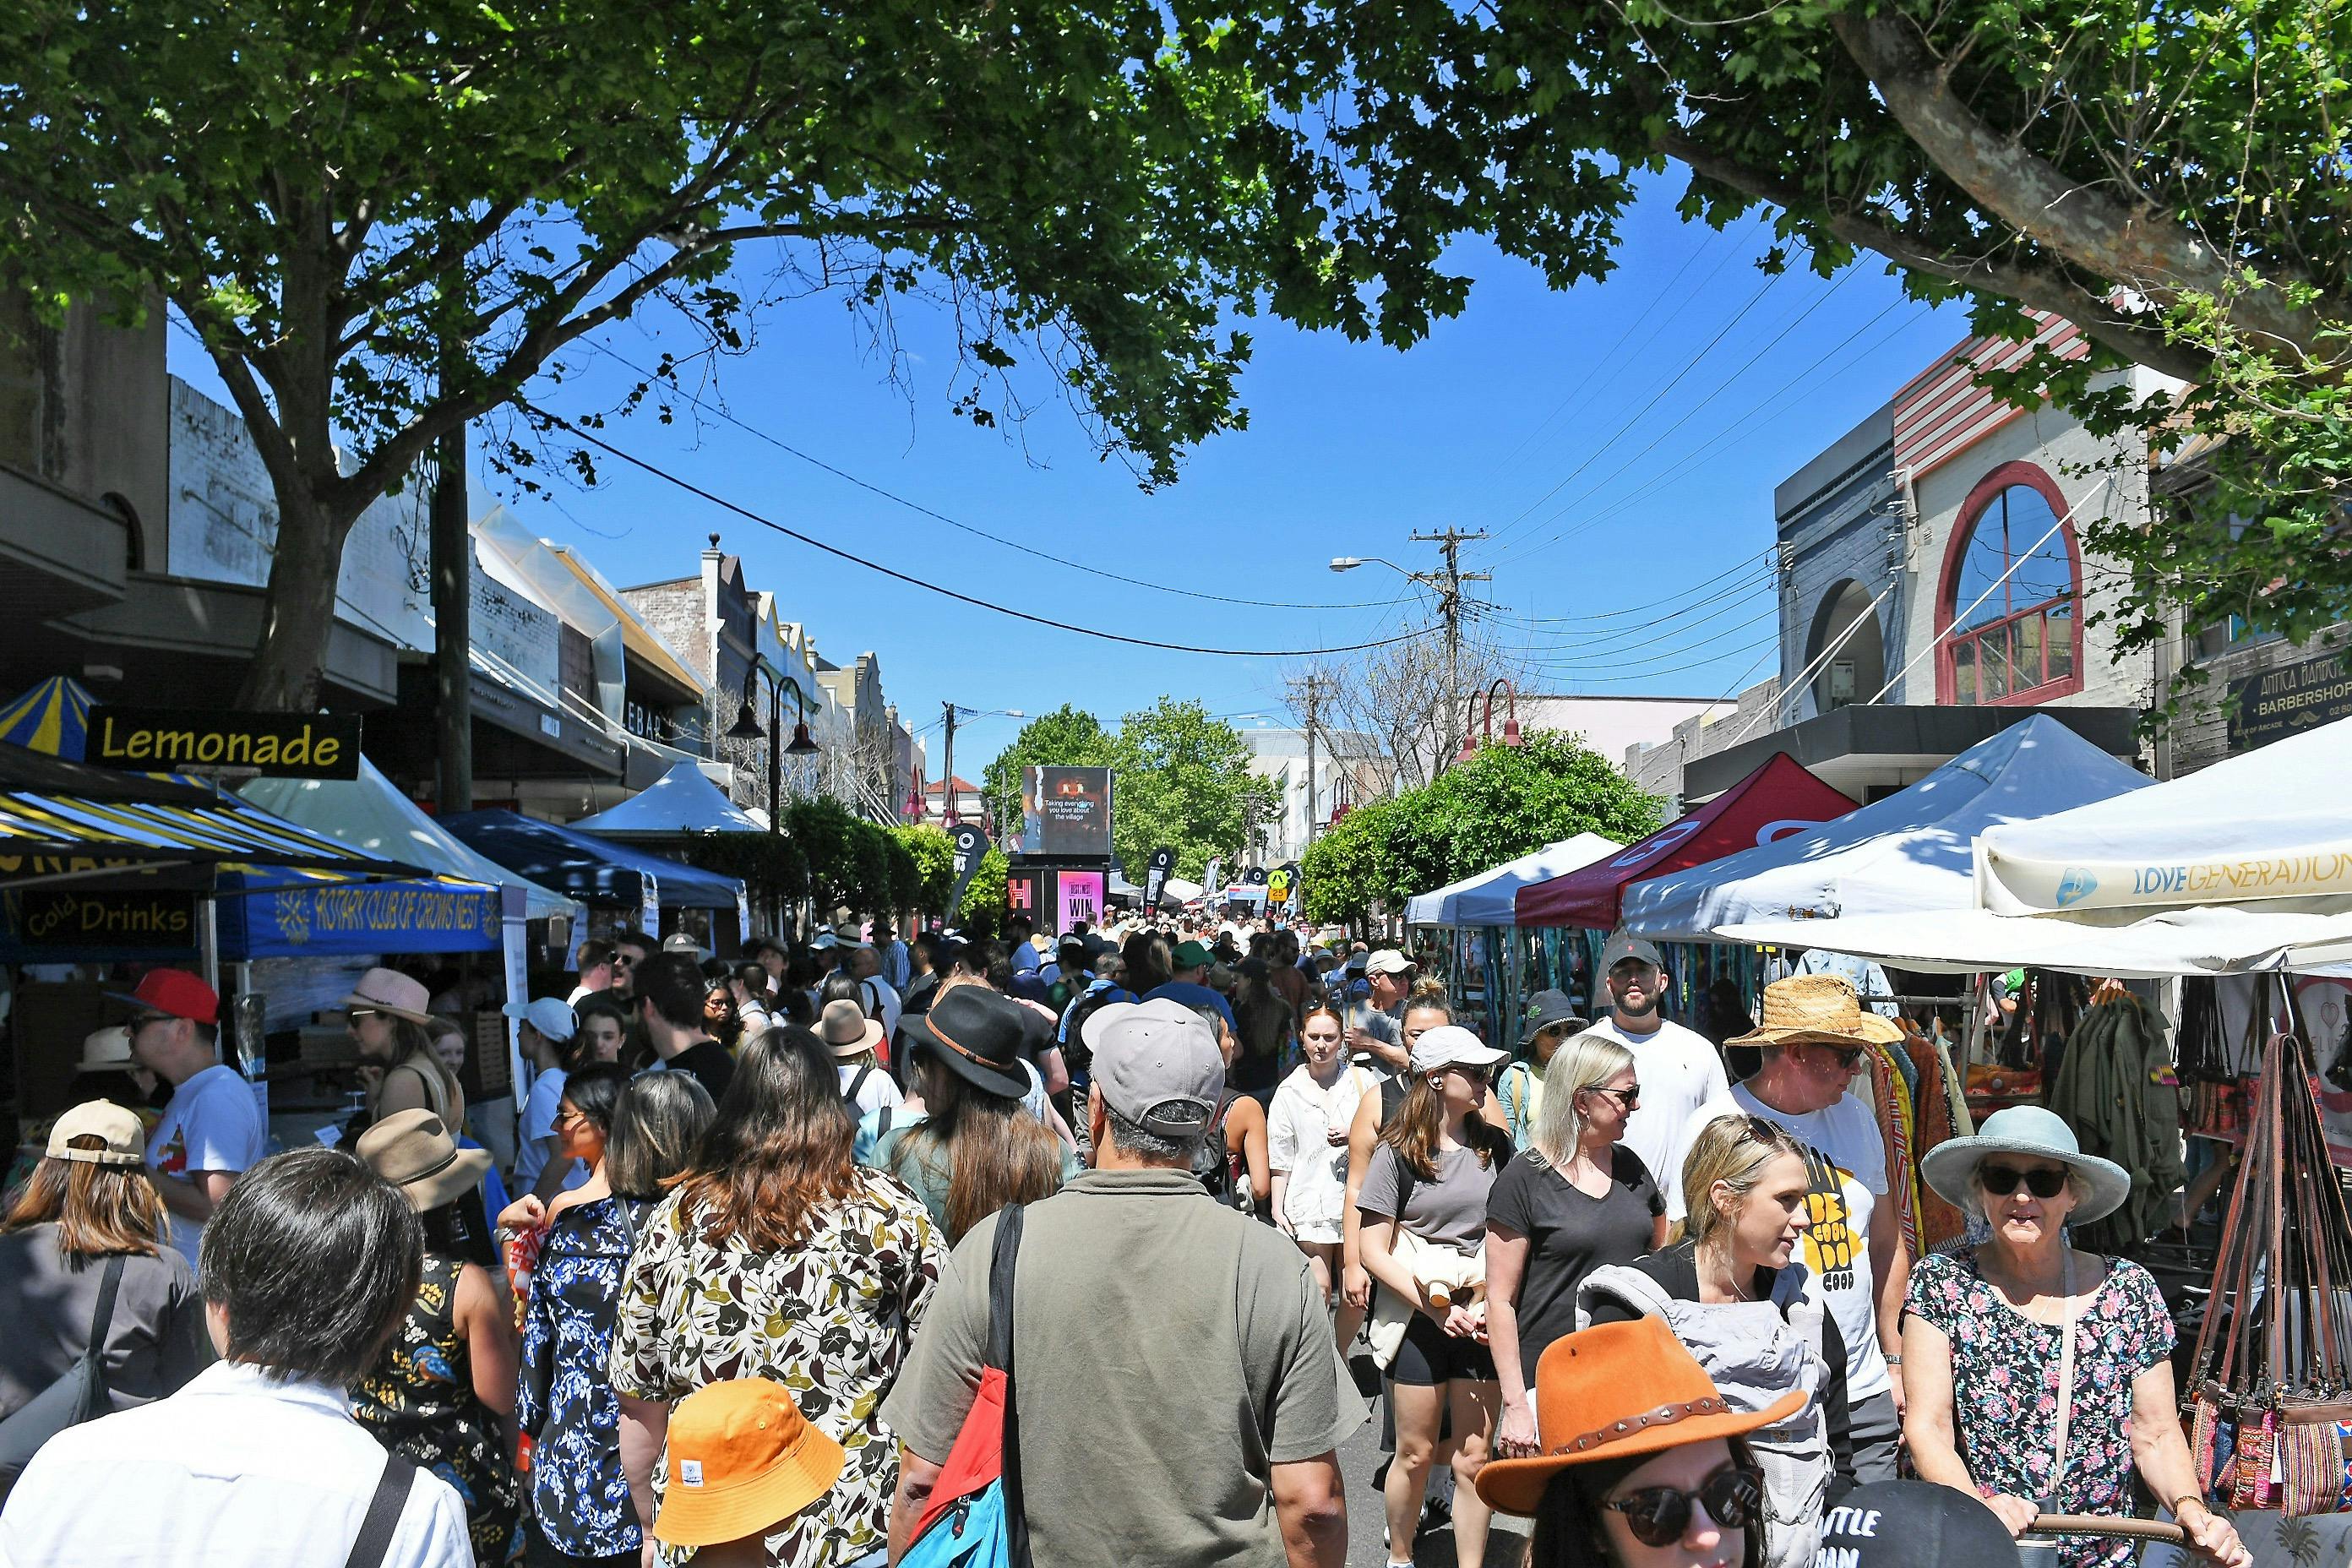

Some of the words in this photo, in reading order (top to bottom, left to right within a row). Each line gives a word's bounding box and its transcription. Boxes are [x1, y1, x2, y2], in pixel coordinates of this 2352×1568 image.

[622, 700, 662, 744] EBAR
[101, 716, 340, 767] Lemonade
[27, 892, 79, 937] Cold
[80, 900, 188, 932] Drinks
[315, 888, 368, 930] ROTARY
[368, 890, 400, 930] CLUB
[399, 890, 417, 930] OF
[417, 893, 455, 930] CROWS
[454, 894, 482, 930] NEST
[1069, 898, 1092, 917] WIN
[1808, 1192, 1845, 1224] BE
[1812, 1222, 1847, 1243] GOOD
[1821, 1242, 1849, 1270] DO
[1822, 1271, 1854, 1292] GOOD
